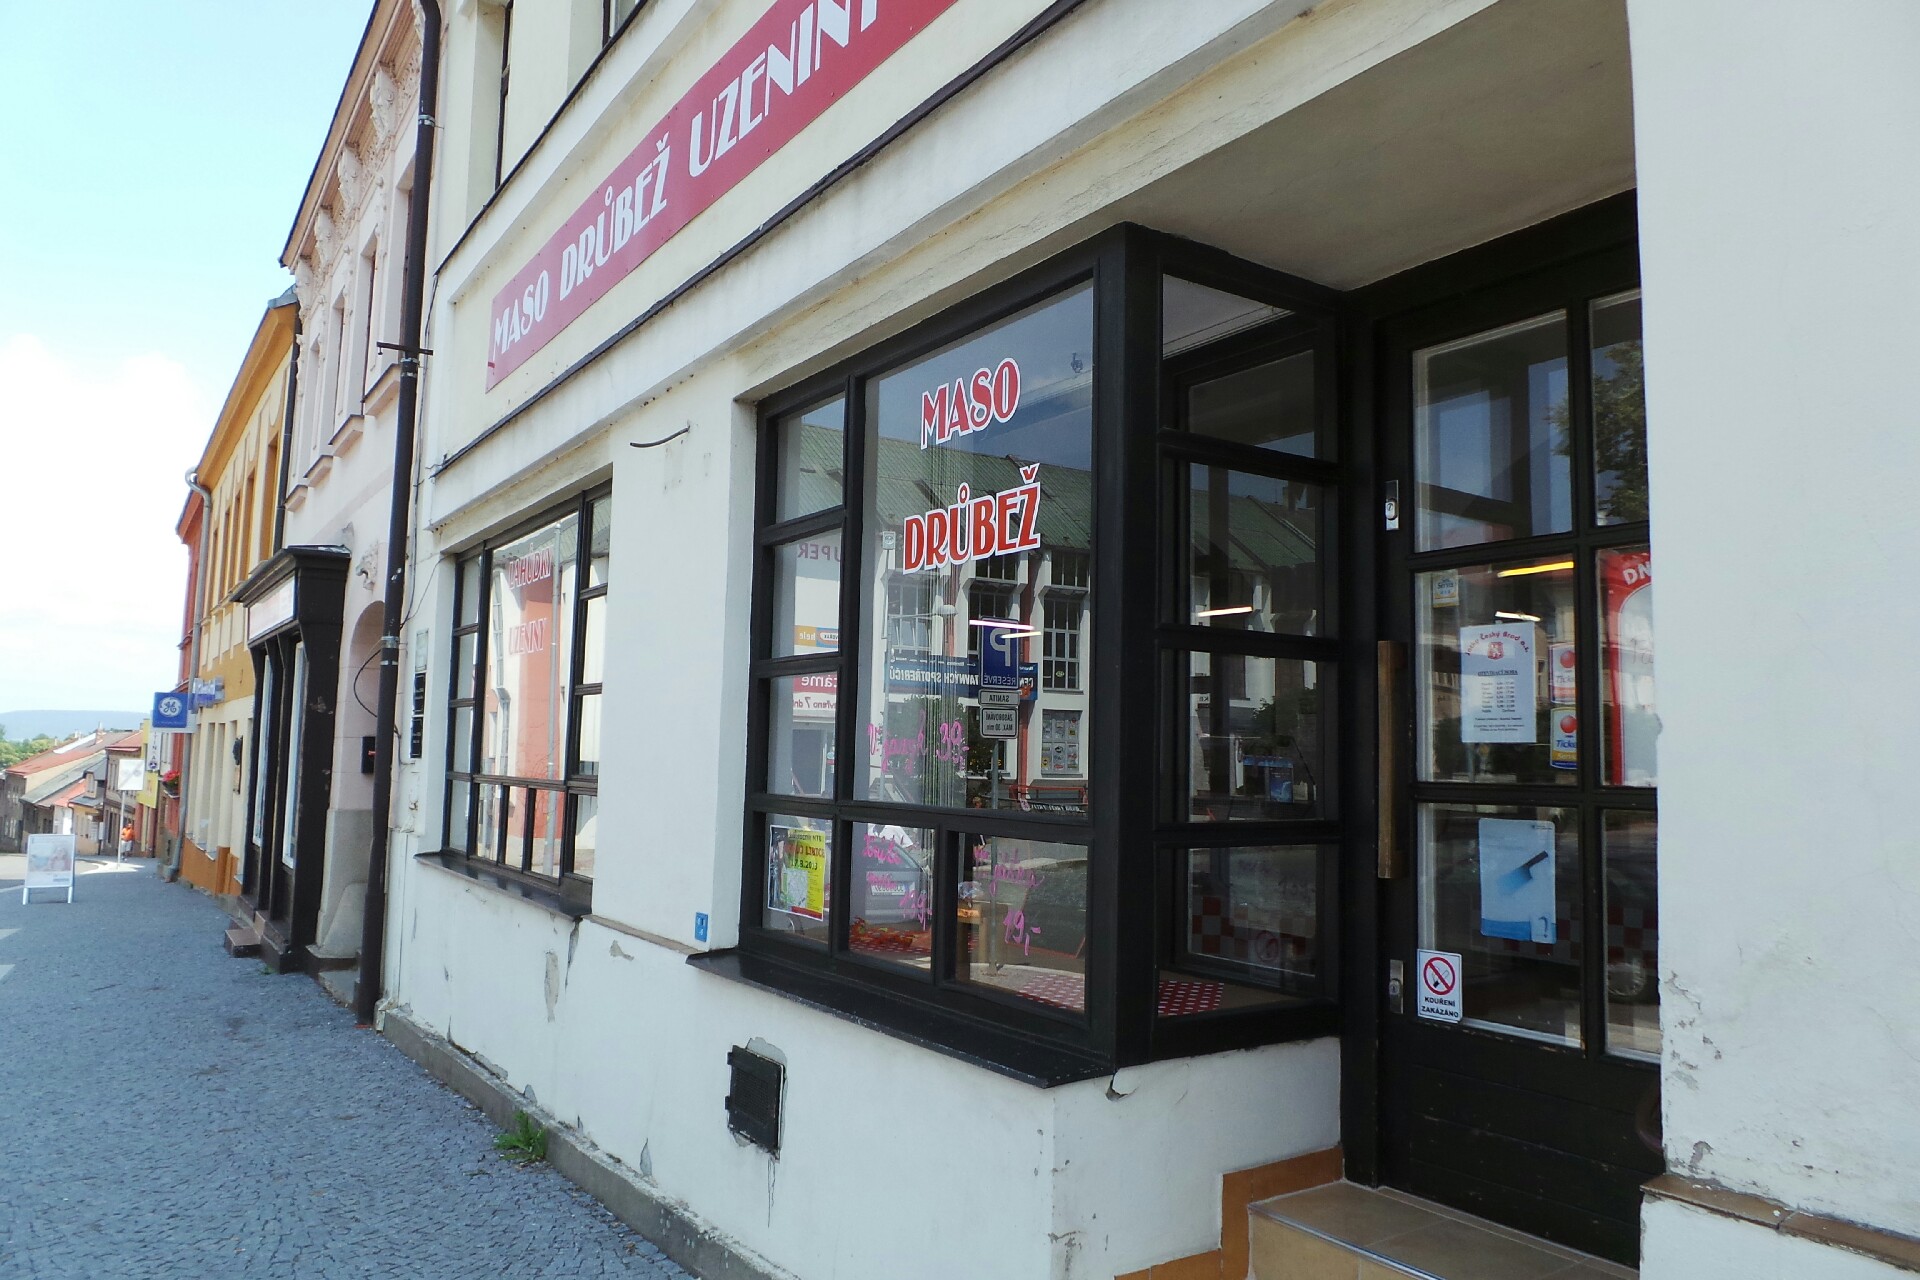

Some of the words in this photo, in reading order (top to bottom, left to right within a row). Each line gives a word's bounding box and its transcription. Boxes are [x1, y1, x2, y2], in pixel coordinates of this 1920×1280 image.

[493, 271, 549, 361] MASO
[558, 133, 671, 301] DRŮBEŽ
[920, 357, 1021, 450] MASO
[903, 462, 1041, 575] DRŮBEŽ
[1502, 630, 1520, 641] Brod
[1421, 1005, 1459, 1018] ZAKÁZÁNO
[1424, 996, 1456, 1007] KOUŘENÍ
